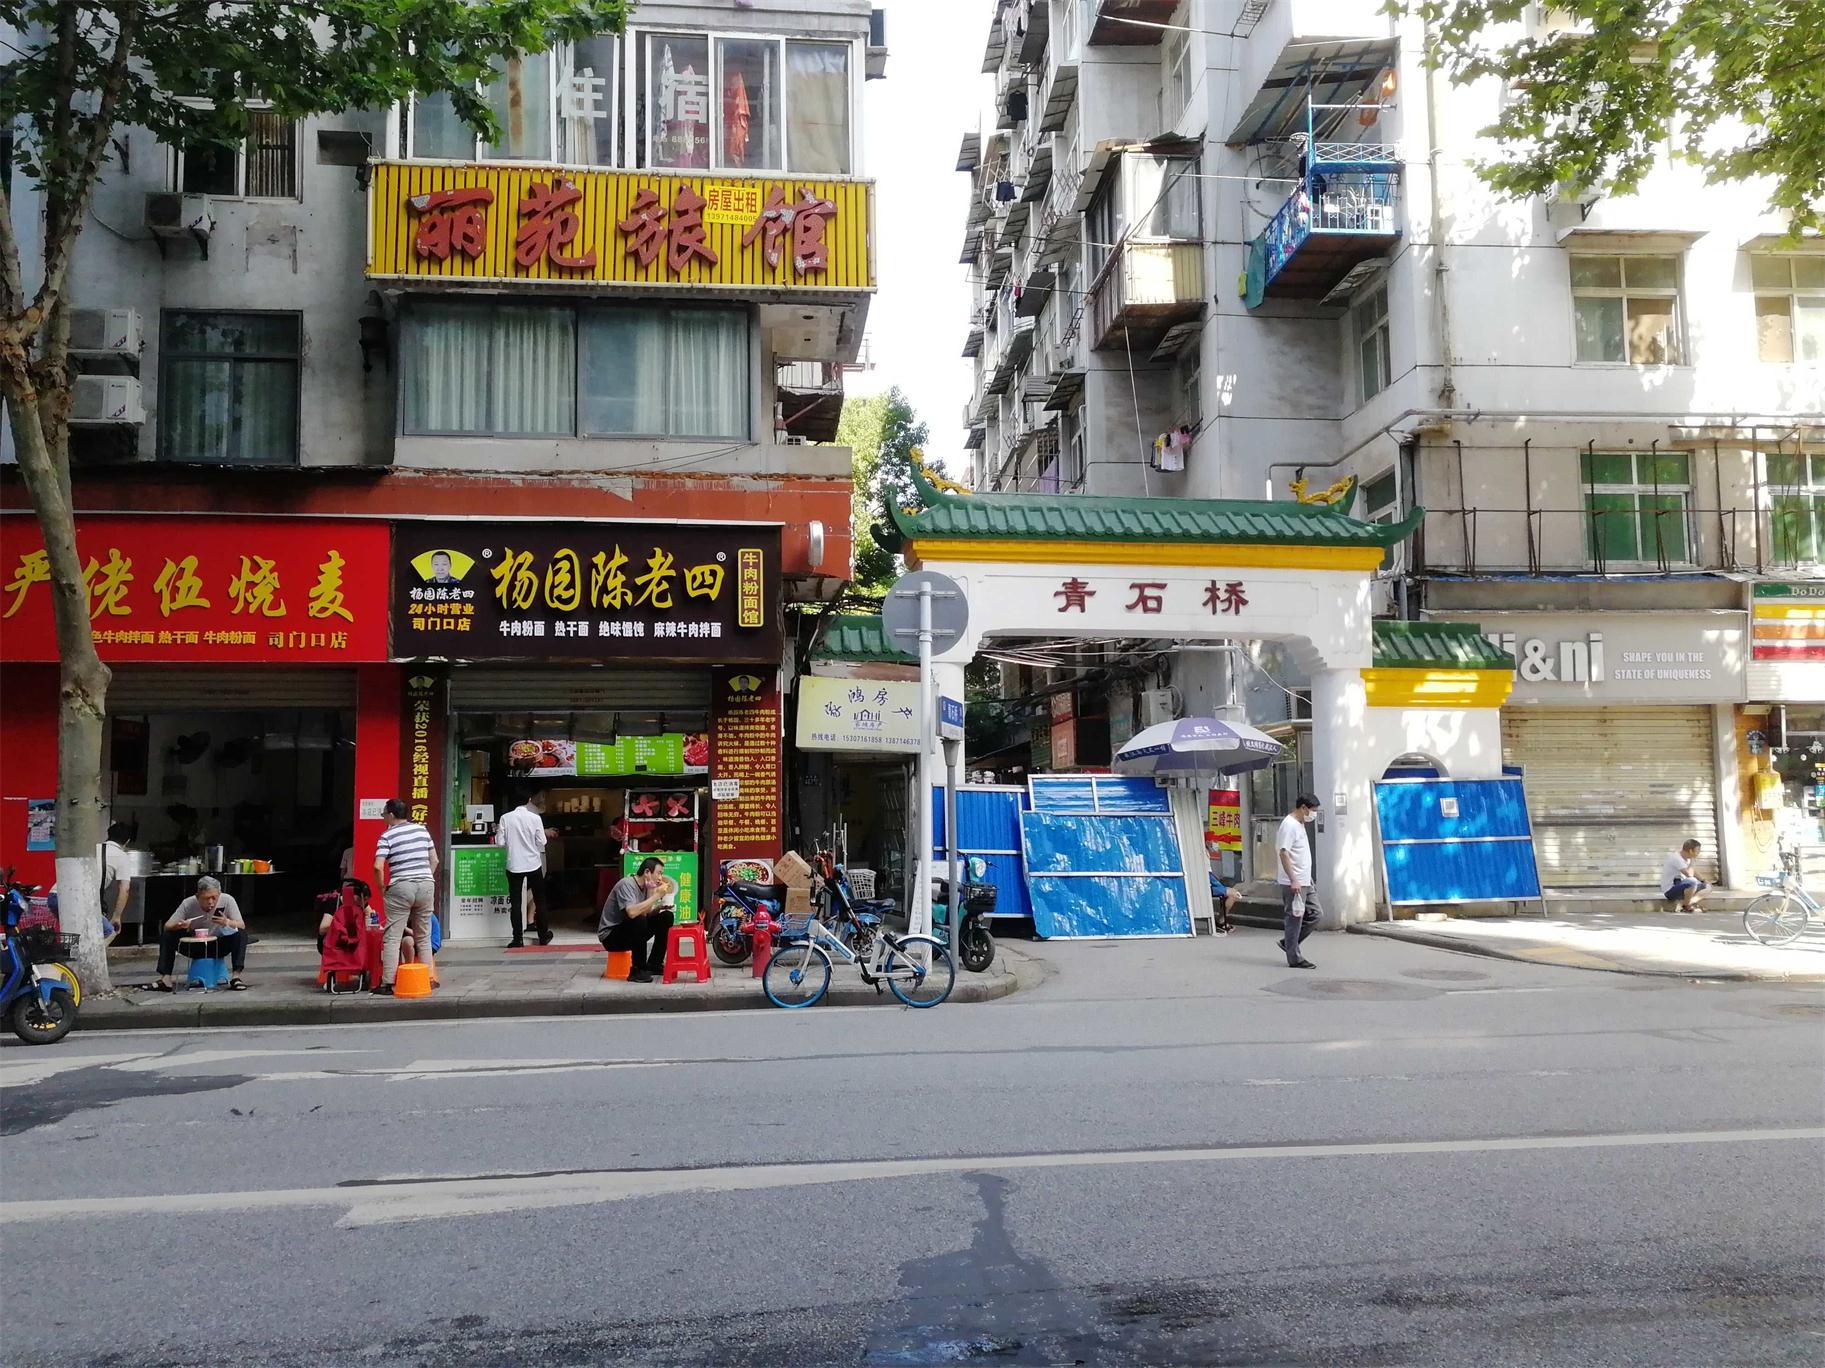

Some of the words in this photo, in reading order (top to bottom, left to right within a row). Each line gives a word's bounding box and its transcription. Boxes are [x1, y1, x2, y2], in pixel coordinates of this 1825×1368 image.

[708, 188, 757, 213] 房屋出租
[408, 177, 838, 276] 丽苑旅馆
[2, 548, 355, 622] 严佬伍烧麦
[490, 543, 724, 612] 杨园陈老四
[409, 587, 475, 601] 杨园陈老四
[743, 553, 760, 625] 牛肉粉面馆
[1053, 576, 1249, 615] 青石桥
[408, 603, 475, 615] 24小时营业
[412, 617, 472, 631] 司门口店
[499, 620, 545, 637] 牛肉粉面
[554, 620, 589, 637] 热干面
[598, 620, 645, 638] 绝味馄饨
[653, 620, 722, 638] 麻辣牛肉拌面
[158, 630, 199, 645] 热干面
[203, 631, 256, 645] 牛肉粉面
[267, 630, 348, 650] 司门口店
[1623, 652, 1652, 663] SHAPE
[1655, 652, 1674, 663] YOU
[1676, 652, 1685, 663] IN
[1687, 652, 1704, 663] THE
[1614, 669, 1642, 680] STATE
[1644, 669, 1656, 680] OF
[1657, 669, 1712, 681] UNIQUENESS
[680, 872, 692, 920] 健康油
